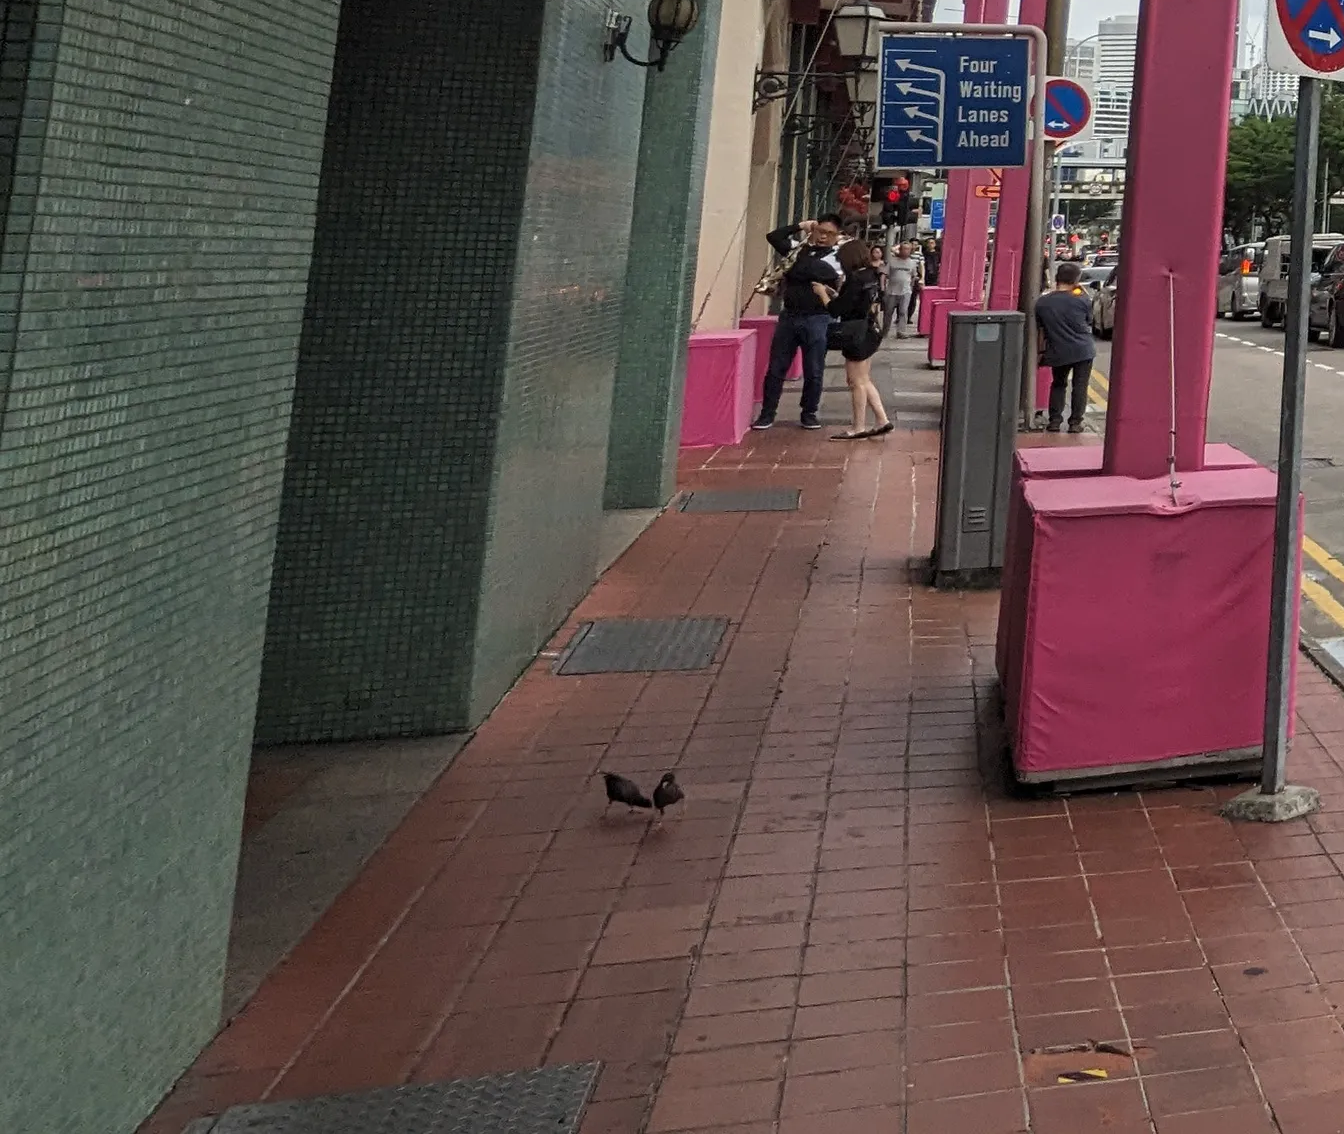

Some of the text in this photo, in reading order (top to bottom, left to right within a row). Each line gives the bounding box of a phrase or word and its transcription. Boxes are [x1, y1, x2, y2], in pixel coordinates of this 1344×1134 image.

[959, 56, 998, 74] Four
[959, 80, 1022, 103] Waiting
[957, 106, 1009, 123] Lanes
[957, 130, 1010, 147] Ahead
